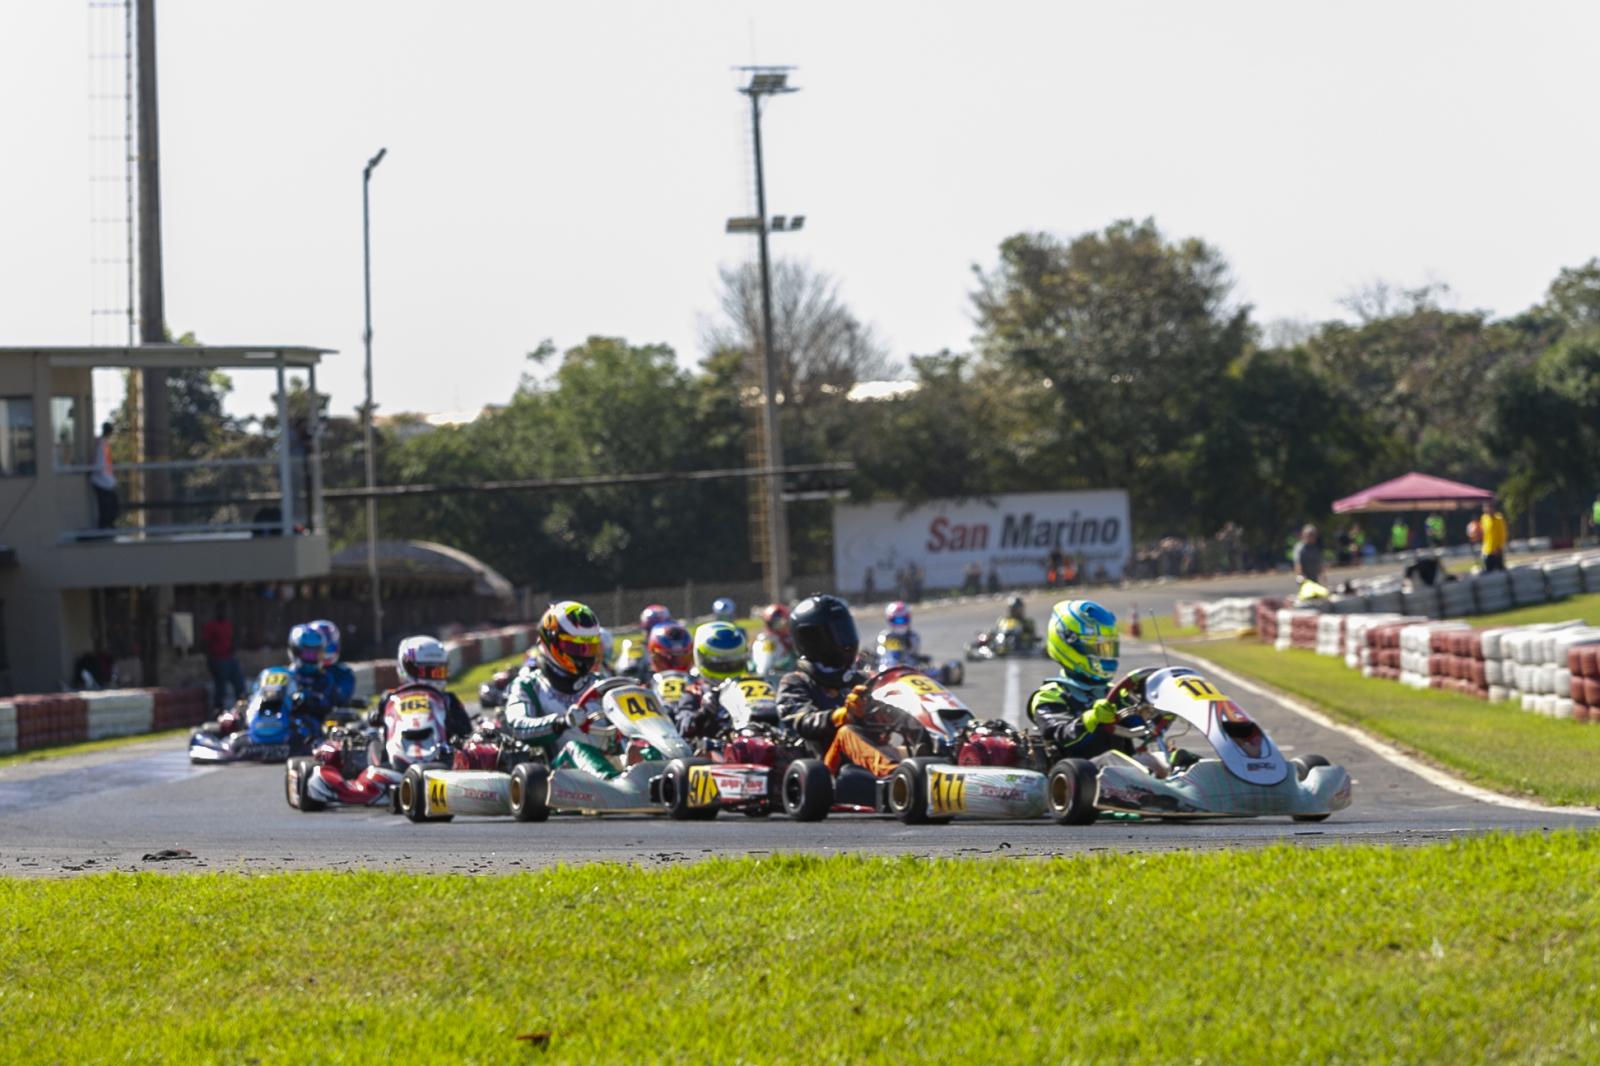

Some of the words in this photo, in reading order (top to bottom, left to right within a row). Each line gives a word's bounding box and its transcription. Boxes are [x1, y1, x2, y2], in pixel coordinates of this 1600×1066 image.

[926, 516, 990, 554] San
[1001, 511, 1121, 550] Marino
[740, 684, 778, 699] 22
[626, 696, 663, 717] 44
[431, 783, 447, 807] 44
[931, 772, 966, 811] 177
